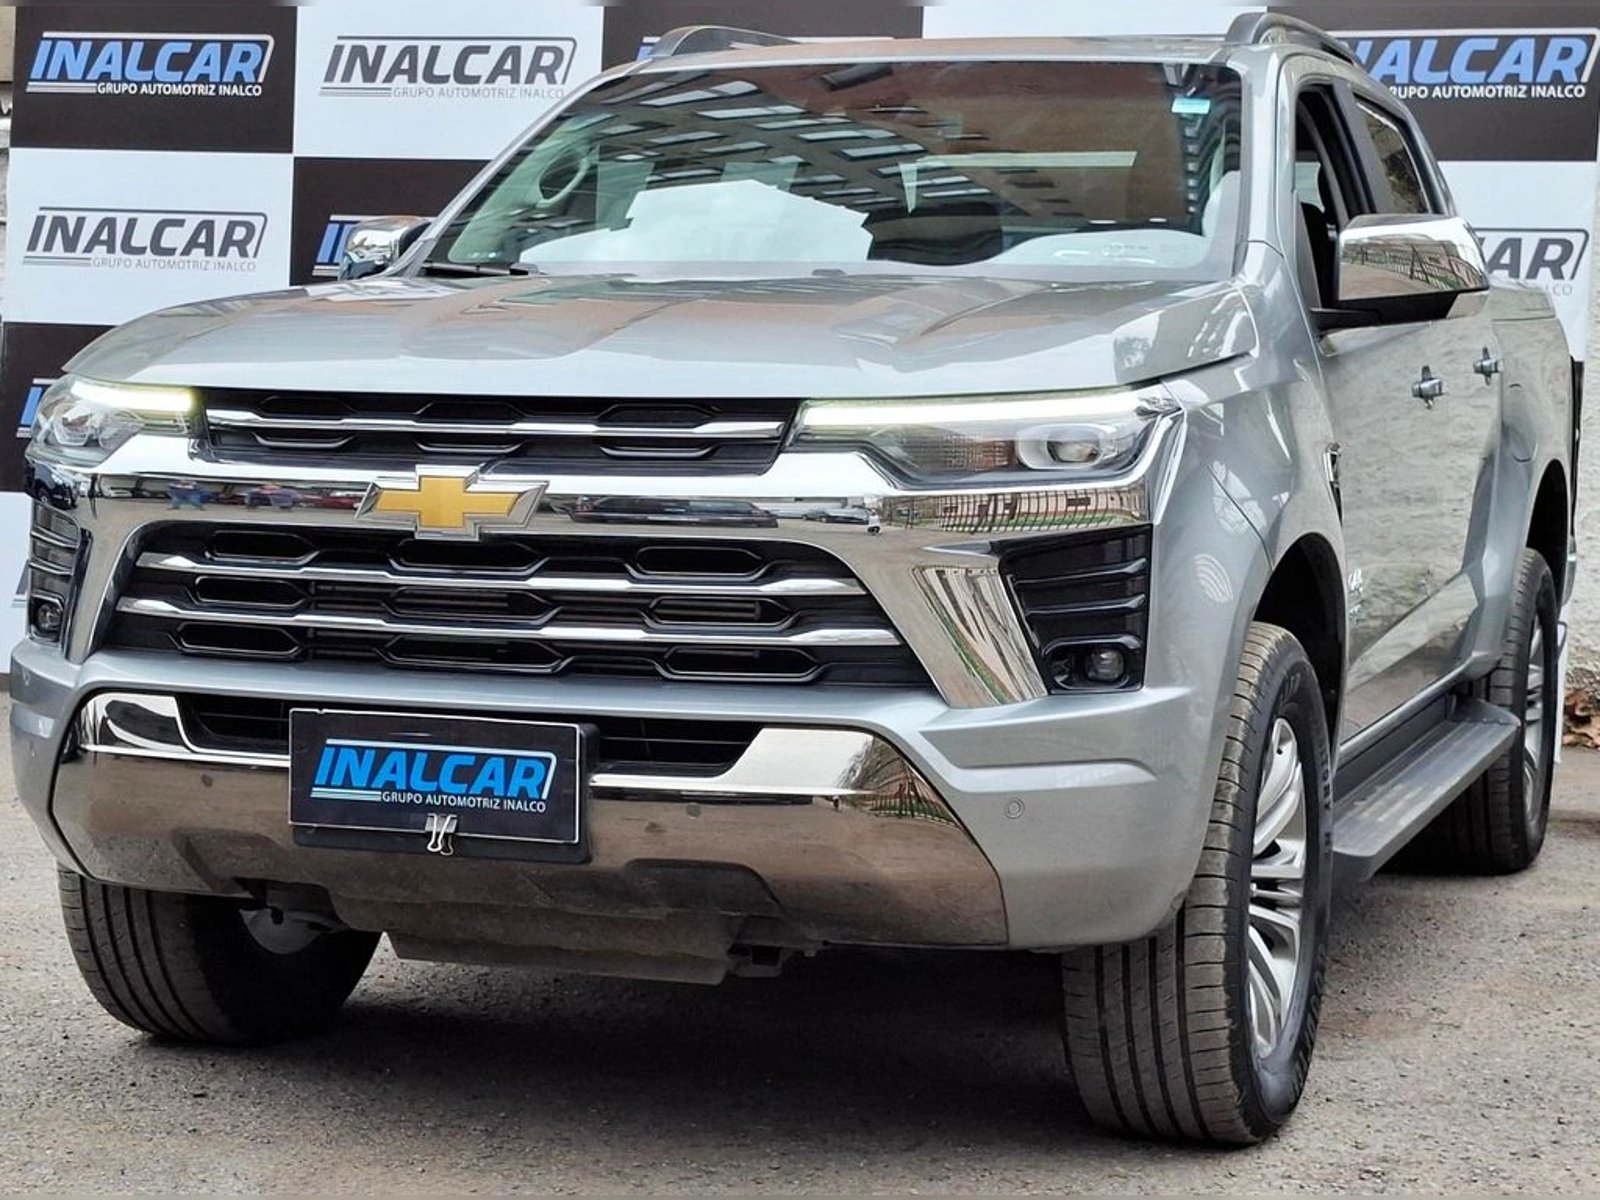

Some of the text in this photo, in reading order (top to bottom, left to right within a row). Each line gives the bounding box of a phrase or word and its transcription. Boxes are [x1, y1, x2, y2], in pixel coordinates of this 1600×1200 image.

[31, 40, 262, 82] INALCAR
[323, 44, 565, 84] INALCAR
[97, 82, 262, 96] GRUPO AUTOMOTRIZ INALCO
[393, 88, 564, 100] GRUPO AUTOMOTRIZ INALCO
[1432, 85, 1527, 98] AUTOMOTRIZ
[1531, 85, 1586, 98] INALCO
[26, 215, 257, 258] INALCAR
[92, 257, 257, 272] GRUPO AUTOMOTRIZ INALCO
[315, 747, 546, 799] INALCAR
[382, 791, 546, 812] GRUPO AUTOMOTRIZ INALCO
